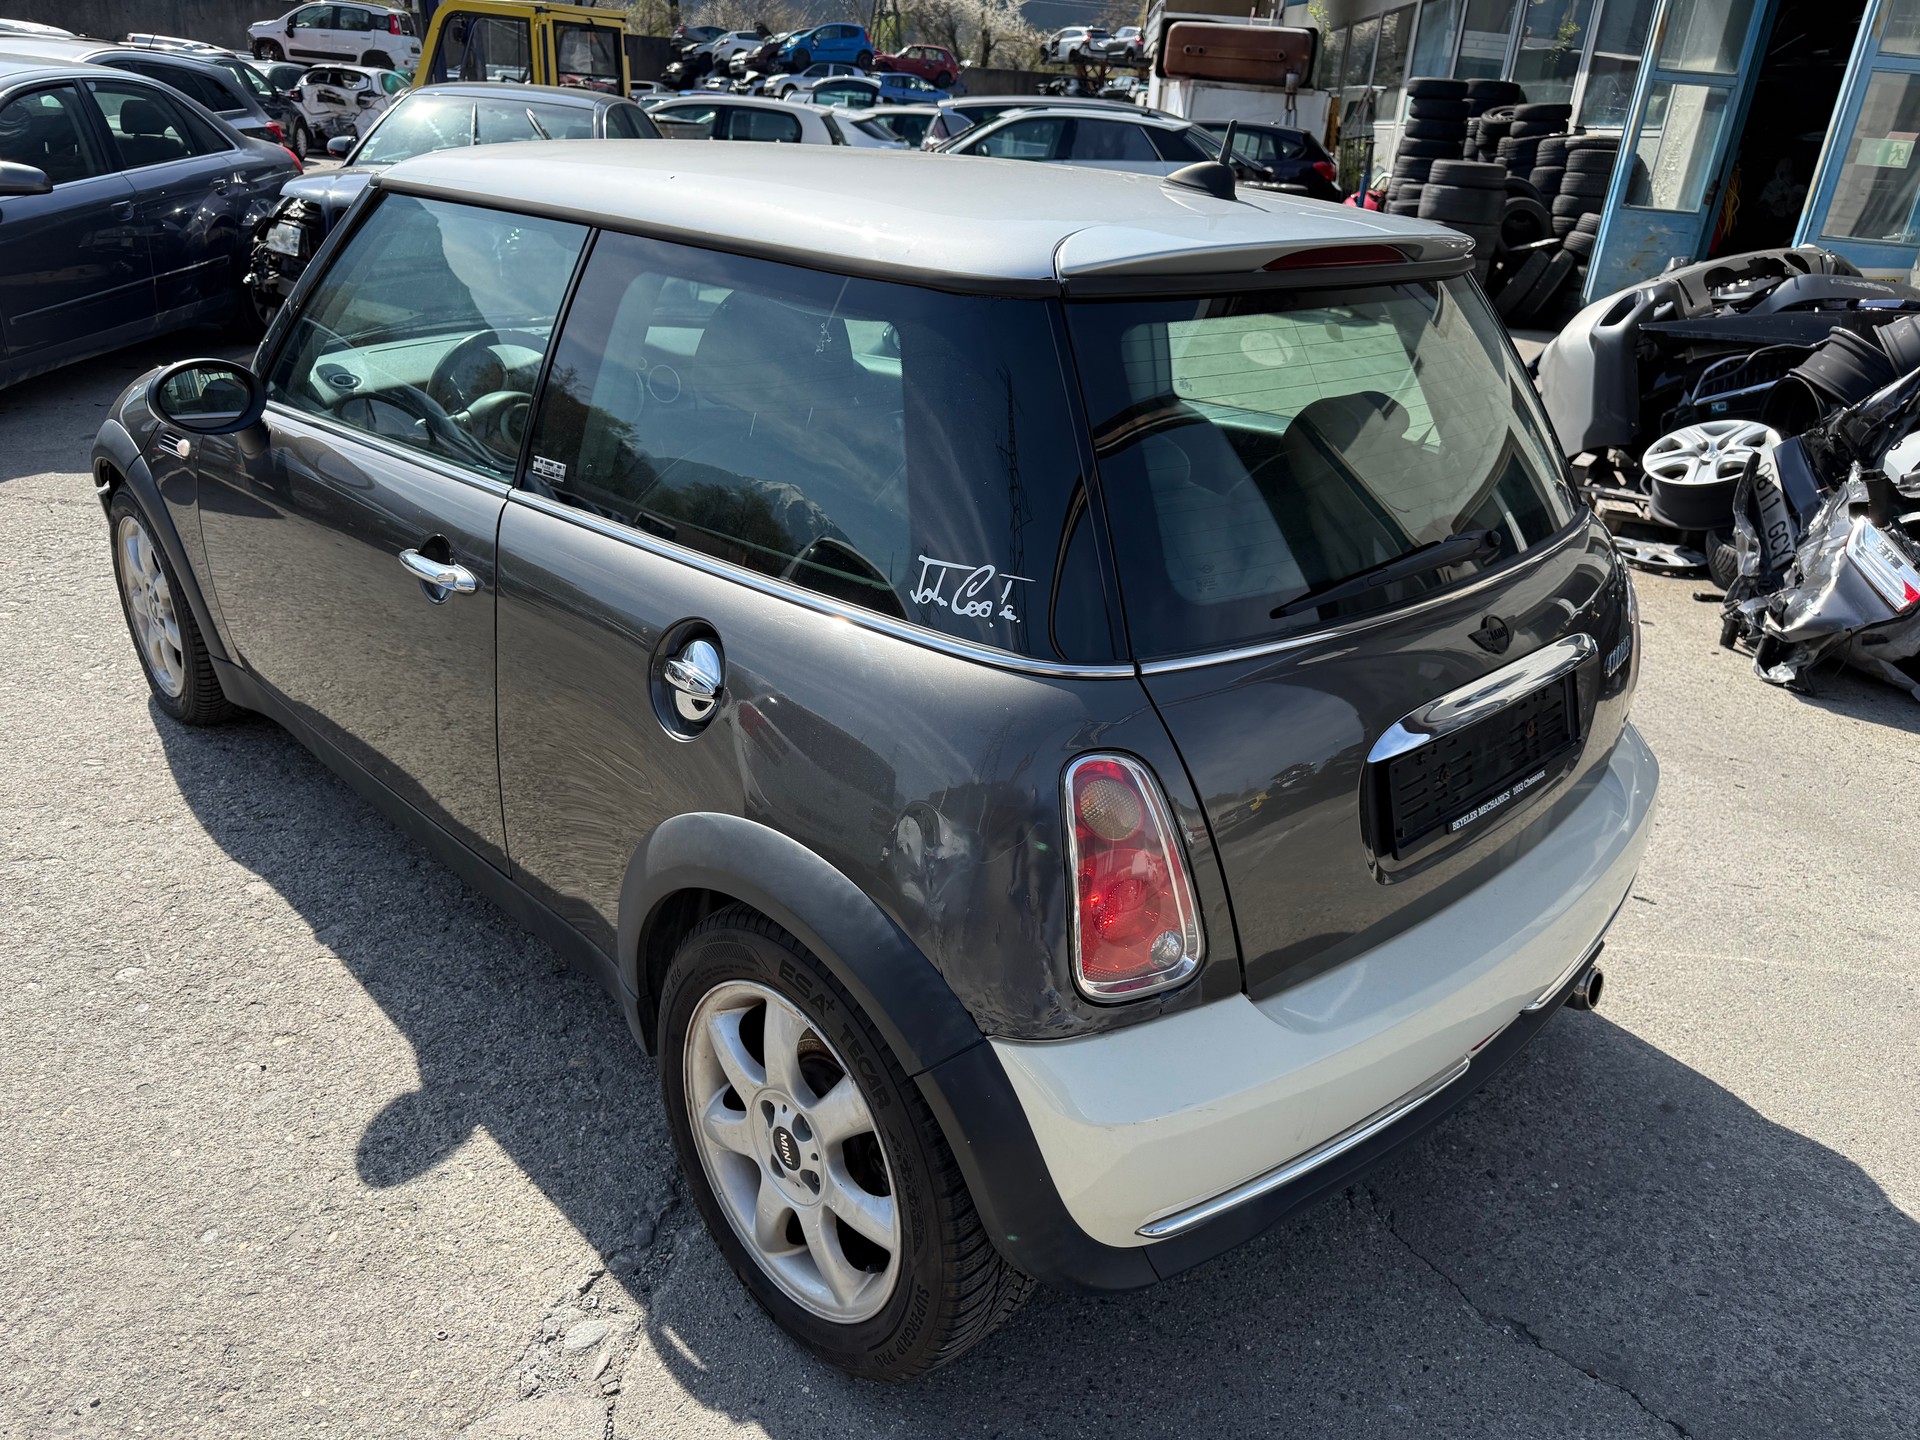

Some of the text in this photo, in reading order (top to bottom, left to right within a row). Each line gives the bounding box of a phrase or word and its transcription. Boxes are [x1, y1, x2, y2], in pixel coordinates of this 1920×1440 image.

[1768, 520, 1792, 559] GCY
[1452, 810, 1479, 831] BEYELER
[1478, 791, 1511, 816] MECHANICS
[1513, 782, 1524, 795] 1033
[838, 1022, 892, 1110] TECAR
[780, 1132, 793, 1166] MINI
[874, 1283, 931, 1368] SUPERGRIP PRO
